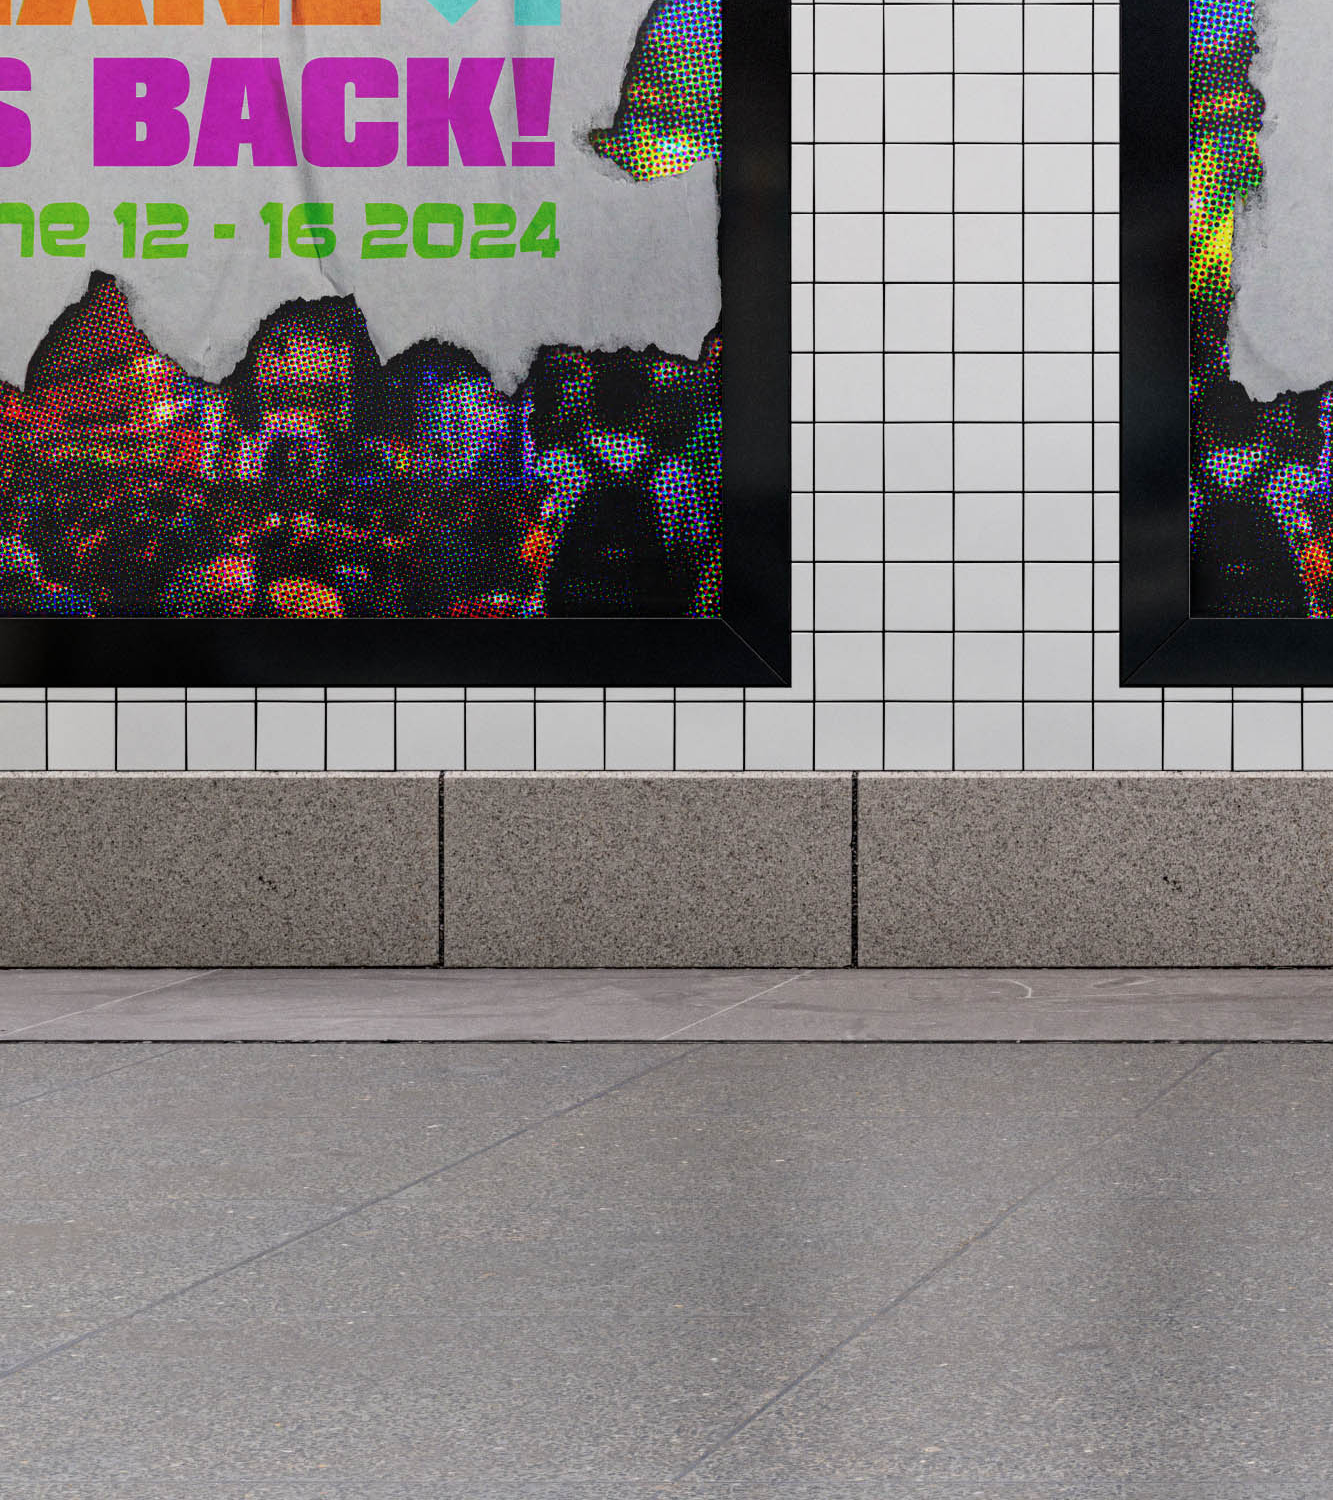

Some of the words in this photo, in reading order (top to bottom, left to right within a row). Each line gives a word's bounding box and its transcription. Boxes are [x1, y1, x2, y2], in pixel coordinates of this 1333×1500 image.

[92, 56, 556, 168] BACK!
[113, 201, 190, 260] 12
[259, 201, 338, 260] 16
[360, 201, 562, 260] 2024
